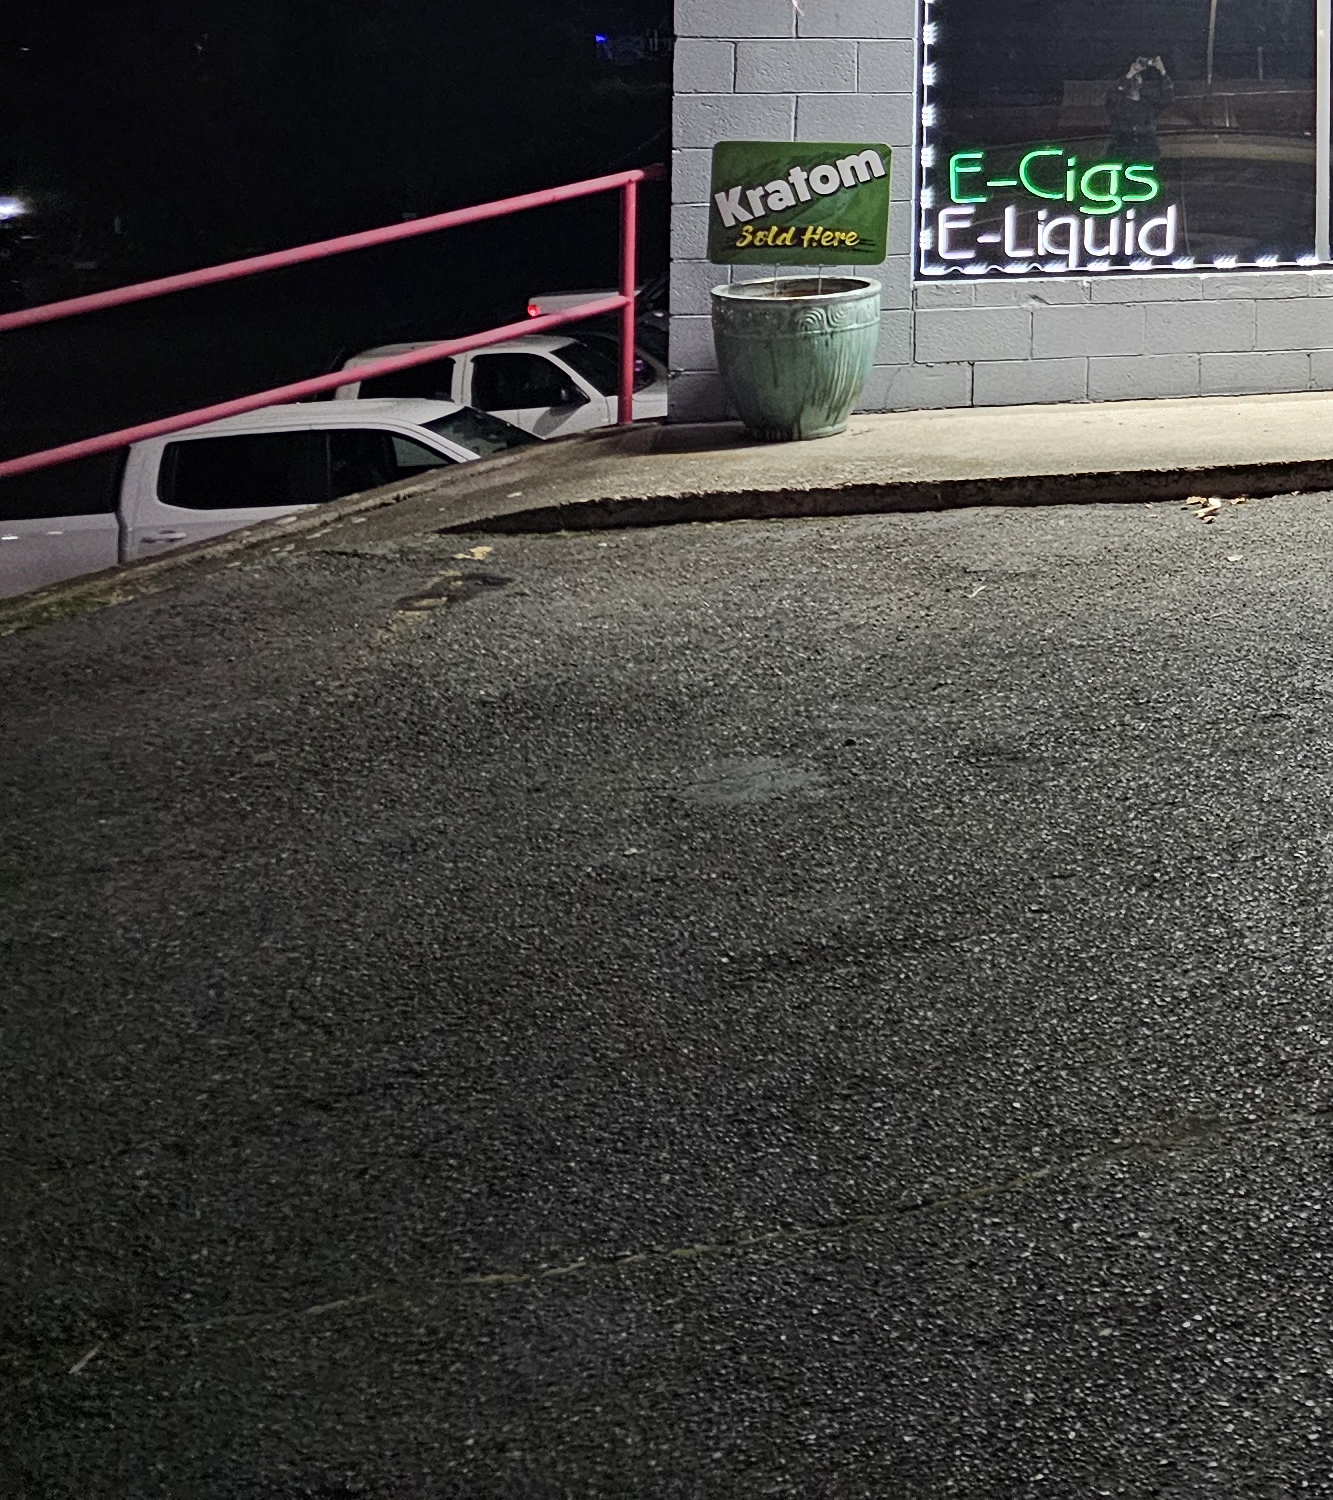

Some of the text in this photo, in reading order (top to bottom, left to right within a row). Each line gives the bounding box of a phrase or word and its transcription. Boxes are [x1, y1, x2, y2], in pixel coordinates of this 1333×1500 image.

[714, 149, 886, 228] Kratom
[949, 149, 1159, 215] E-Cigs
[735, 225, 861, 248] Sold Here
[938, 204, 1177, 269] E-Liquid
